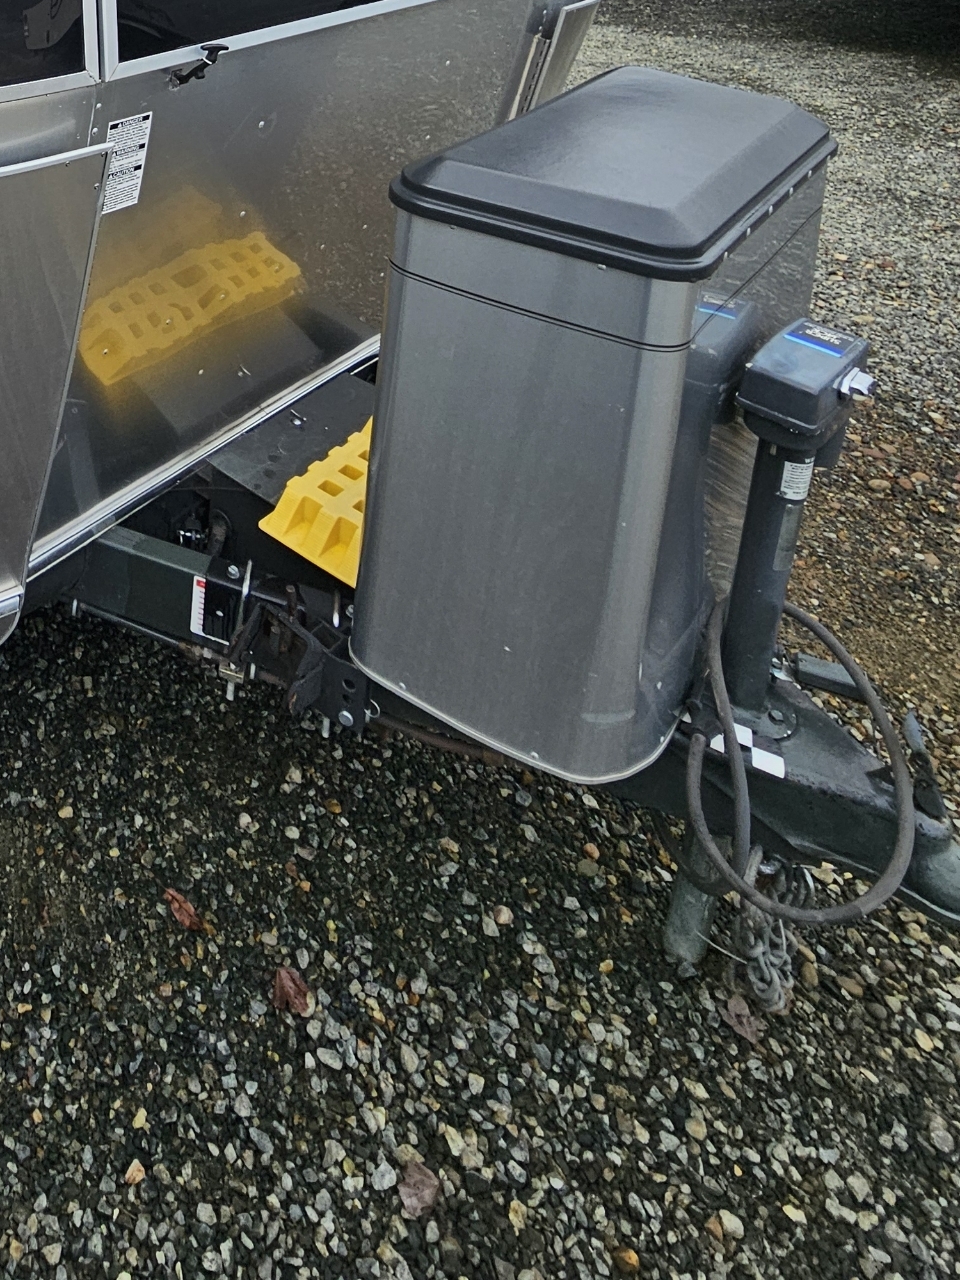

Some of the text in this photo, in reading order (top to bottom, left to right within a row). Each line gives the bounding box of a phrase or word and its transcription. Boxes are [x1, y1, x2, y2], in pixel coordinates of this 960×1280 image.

[123, 116, 143, 127] DANGER
[117, 144, 139, 156] WARNING
[112, 166, 135, 179] CAUTION
